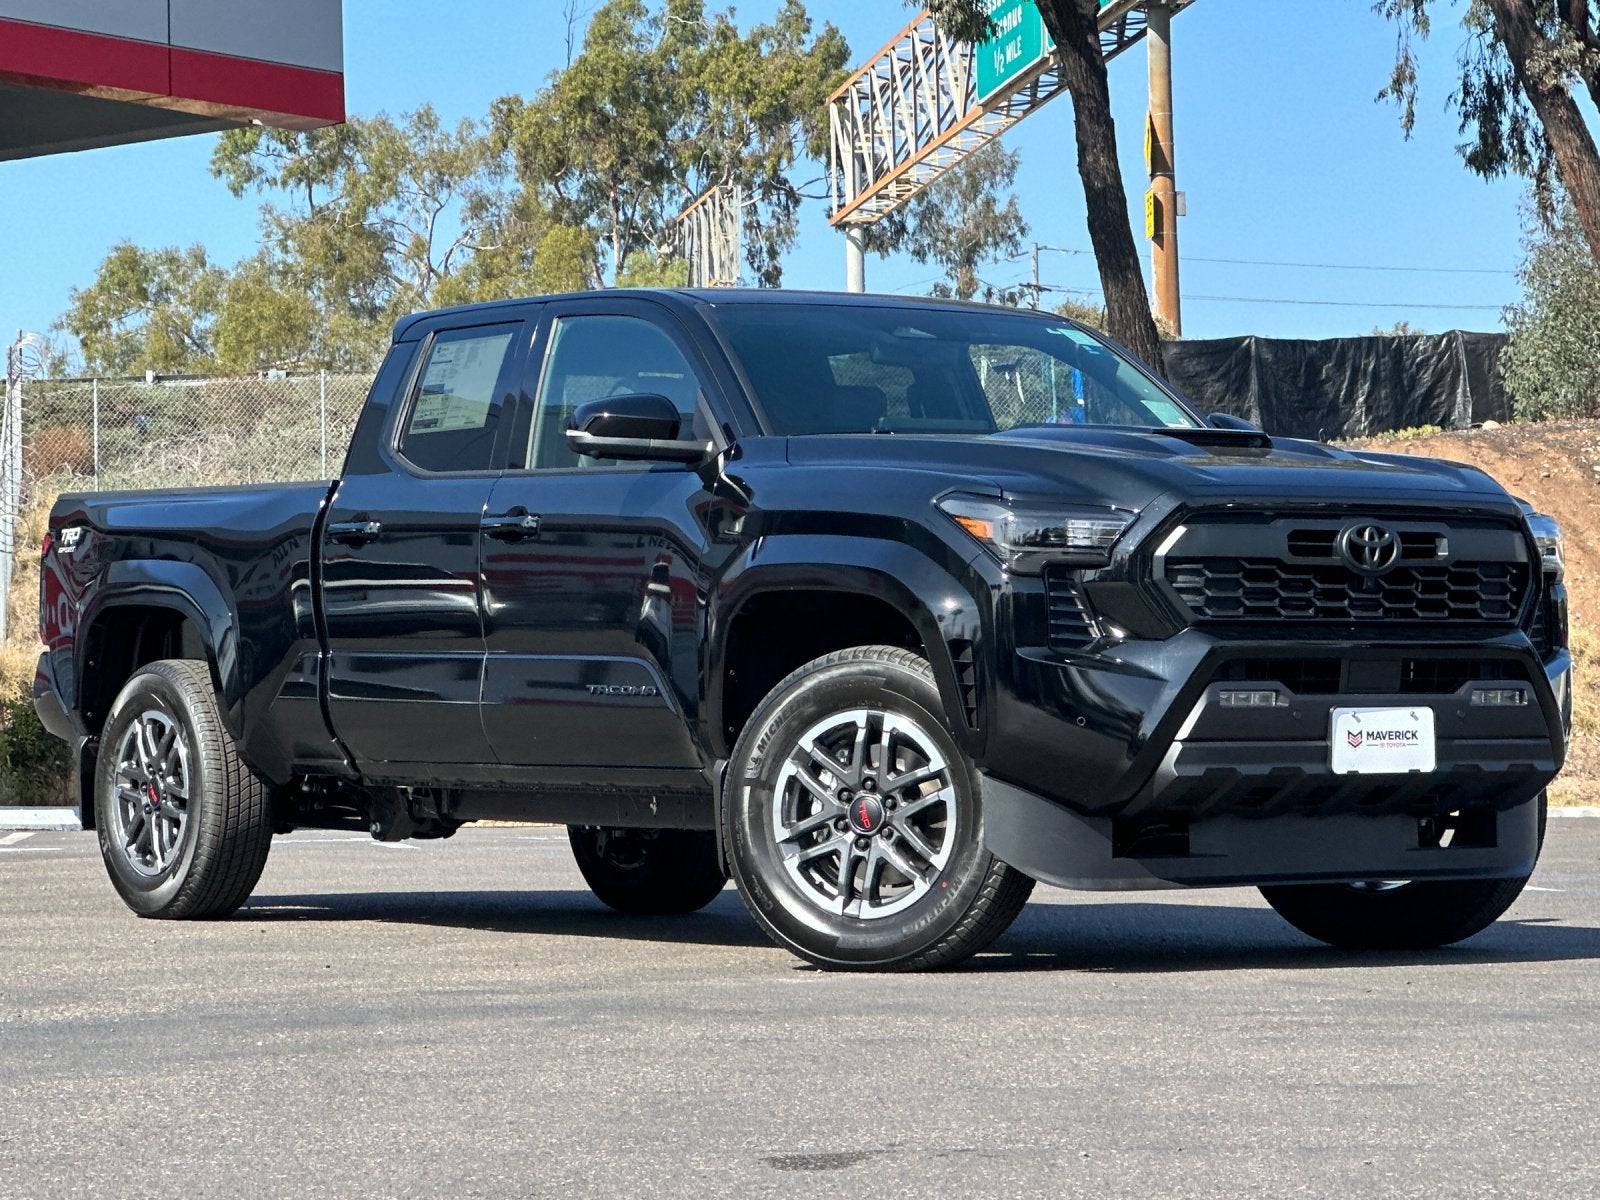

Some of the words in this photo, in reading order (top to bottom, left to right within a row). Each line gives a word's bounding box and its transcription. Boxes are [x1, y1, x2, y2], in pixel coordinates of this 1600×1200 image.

[1006, 35, 1022, 65] MILE
[61, 527, 82, 545] TRD
[585, 684, 657, 696] TACOMA
[1366, 730, 1419, 741] MAVERICK
[858, 800, 871, 829] TRD
